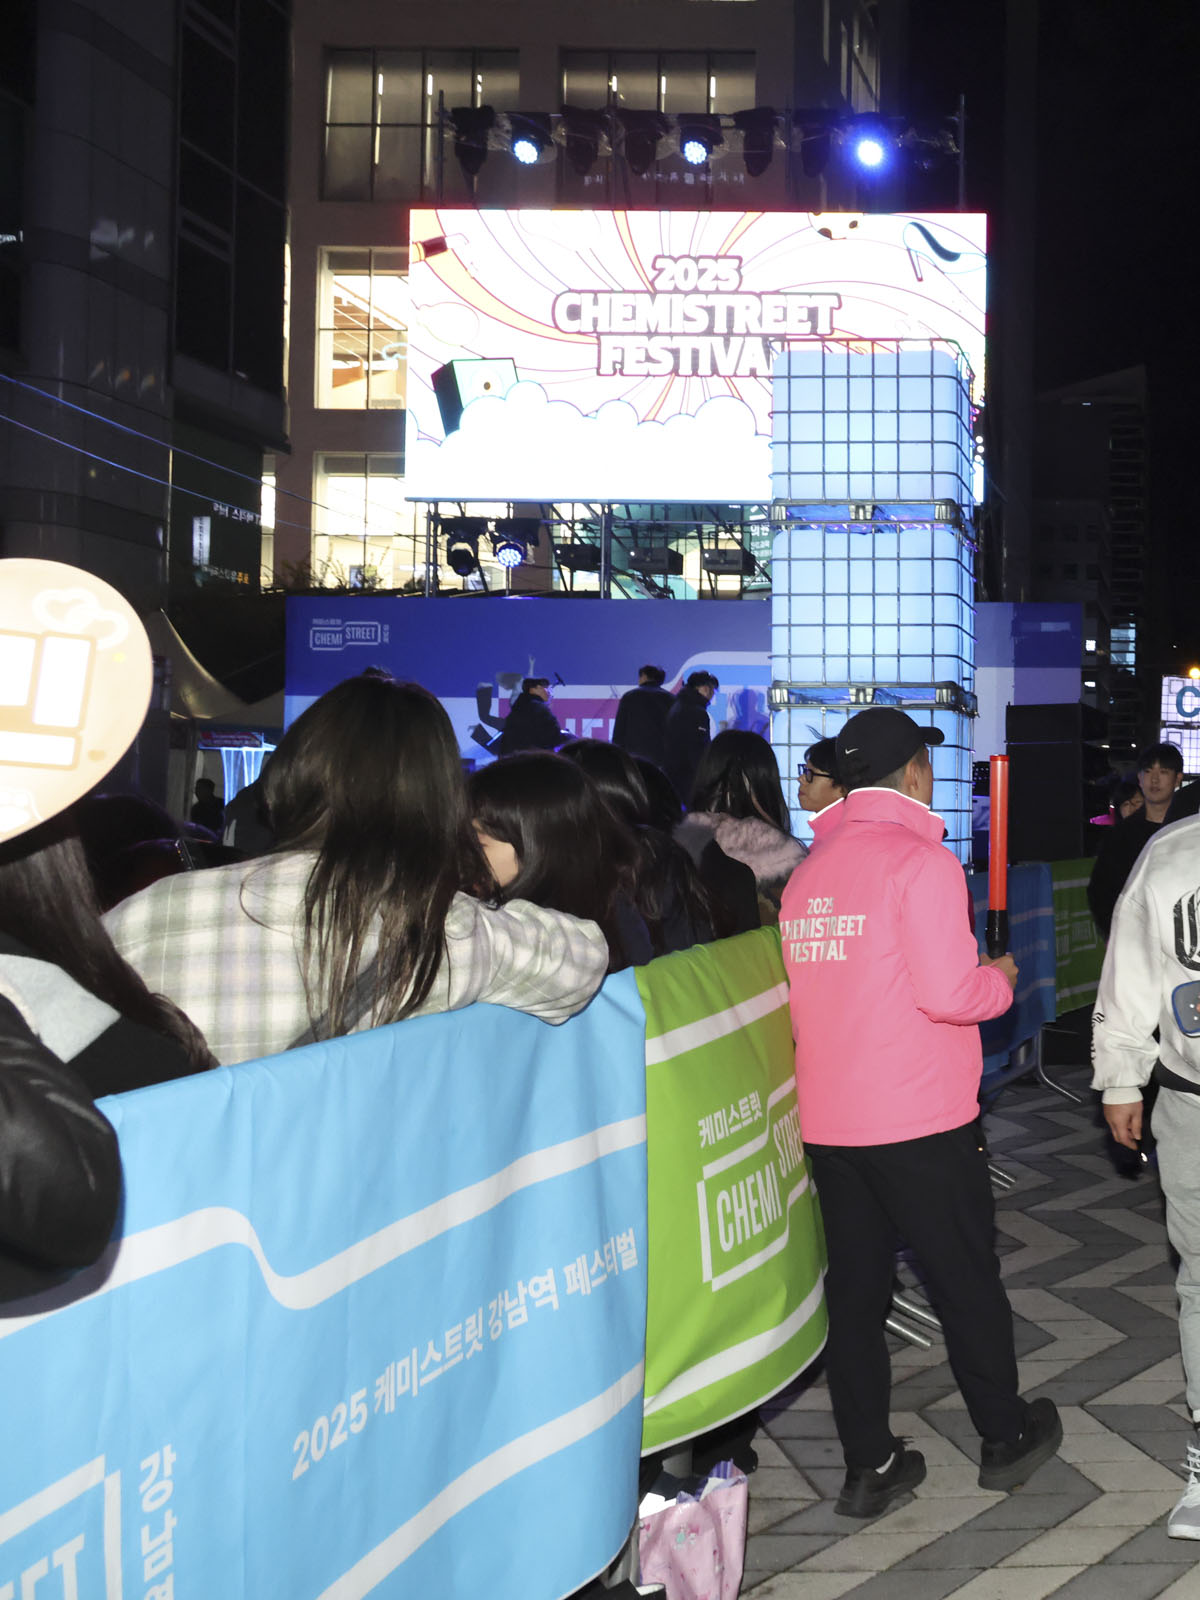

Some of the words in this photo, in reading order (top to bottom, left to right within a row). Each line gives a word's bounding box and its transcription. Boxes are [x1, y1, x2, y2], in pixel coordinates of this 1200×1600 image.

[651, 254, 743, 293] 2025
[552, 291, 843, 335] CHEMISTREET
[597, 334, 785, 377] FESTIVA
[314, 632, 343, 646] CHEMI
[345, 626, 377, 640] STREET
[807, 896, 835, 915] 2025
[698, 1090, 763, 1149] 케미스트릿
[716, 1160, 783, 1253] CHEMI
[292, 1387, 369, 1481] 2025
[373, 1307, 484, 1415] 케미스트릿
[488, 1267, 560, 1341] 강남역
[563, 1227, 640, 1297] 페스티벌
